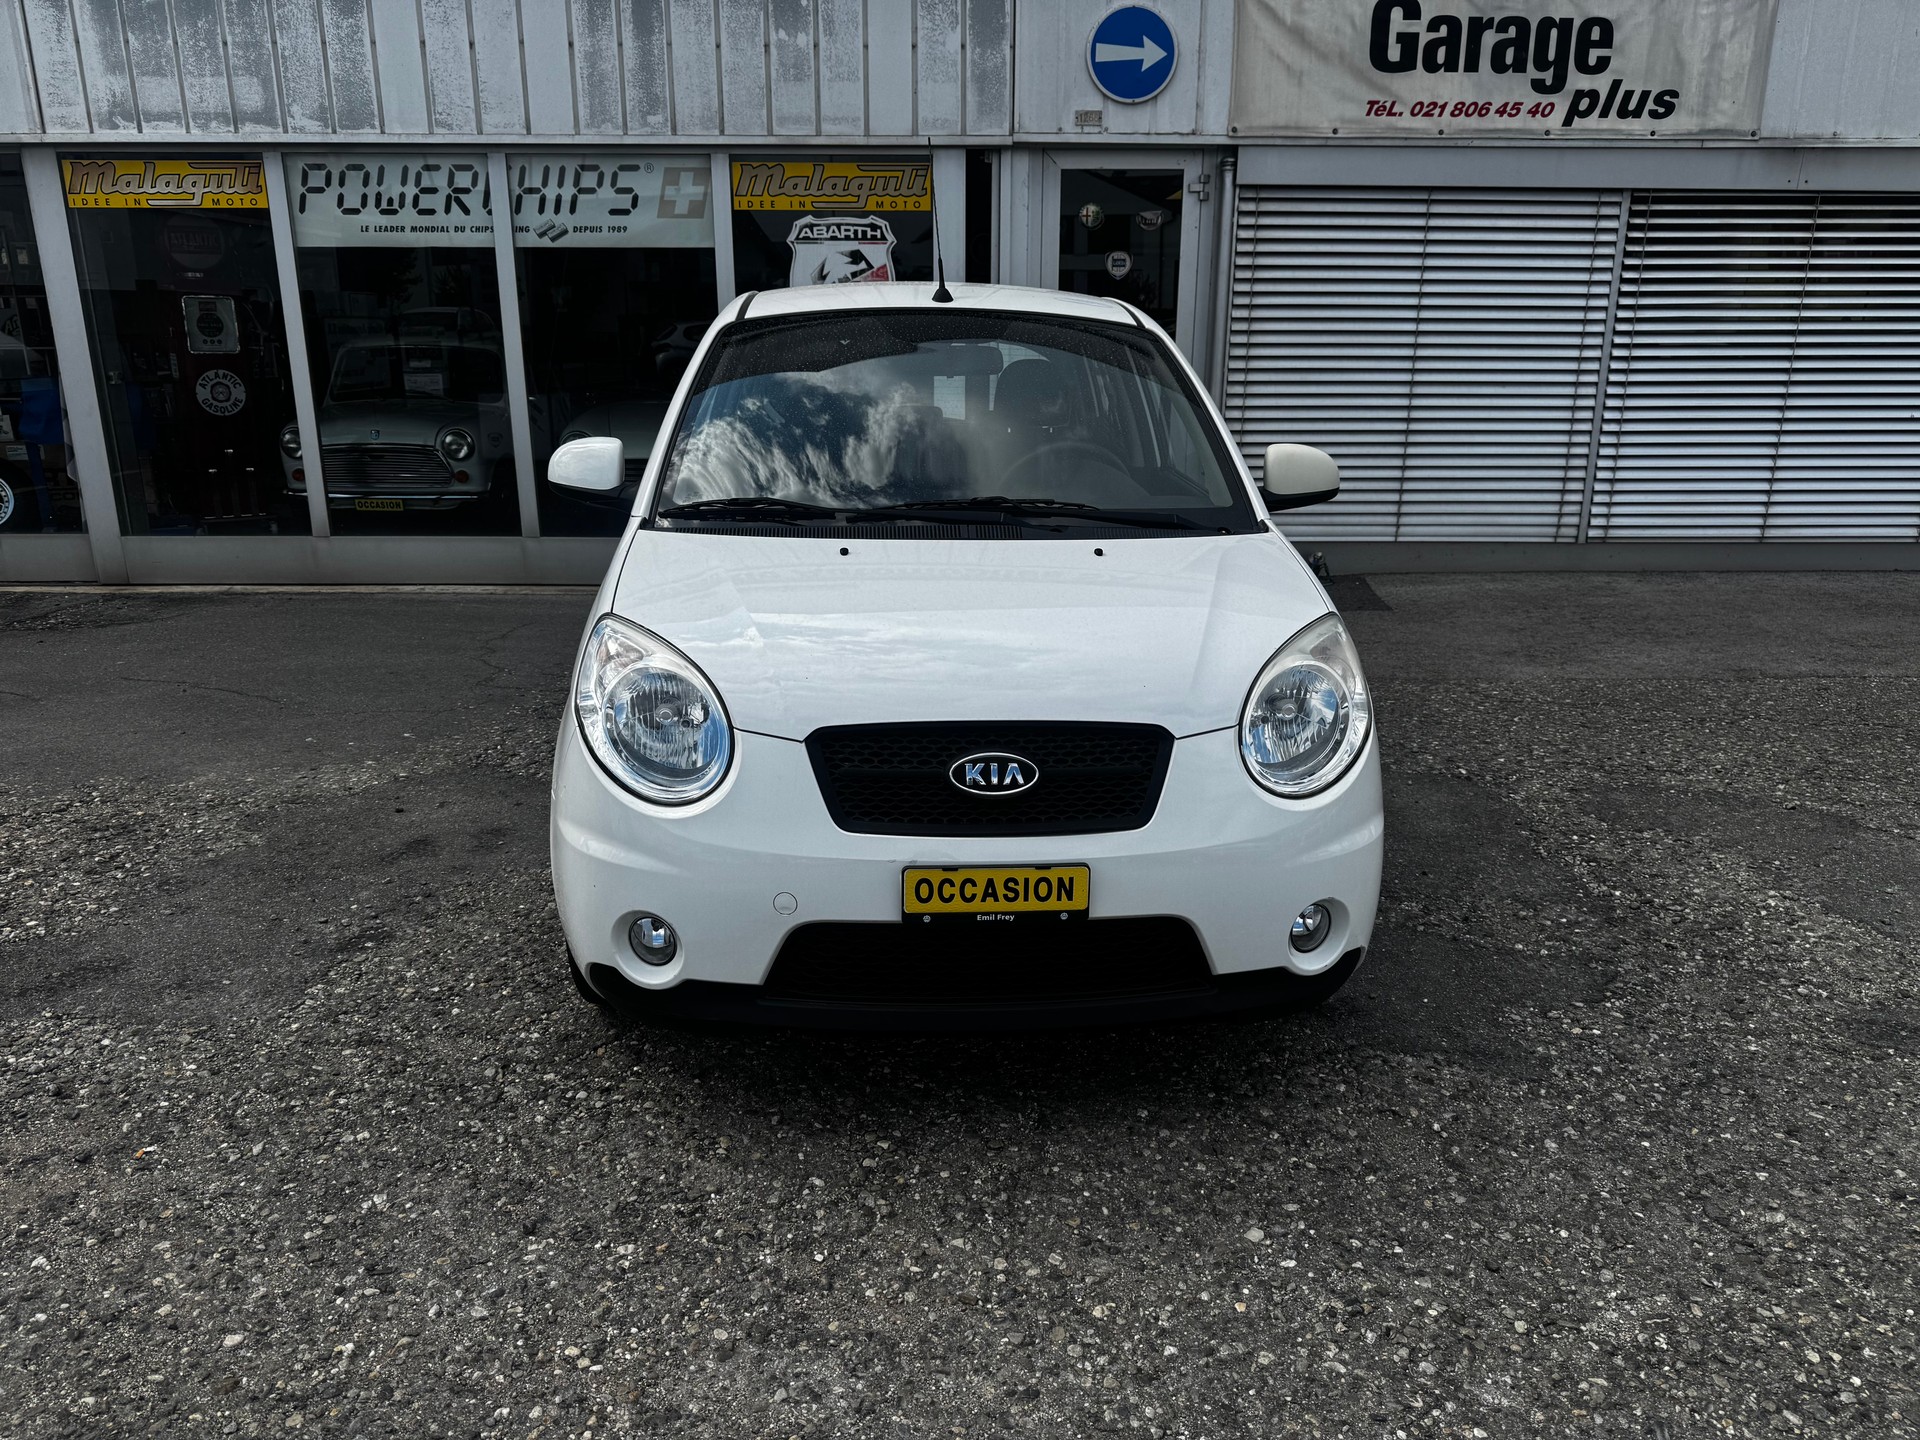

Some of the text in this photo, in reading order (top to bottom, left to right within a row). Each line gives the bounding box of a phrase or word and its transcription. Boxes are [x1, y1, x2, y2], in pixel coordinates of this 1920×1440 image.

[1369, 0, 1614, 94] Garage
[1410, 101, 1448, 117] 021
[1449, 101, 1493, 117] 806
[1494, 102, 1524, 117] 45
[1526, 102, 1555, 118] 40
[1561, 79, 1680, 127] plus
[68, 161, 262, 206] Malaguti
[735, 163, 929, 209] Malaguti
[72, 198, 258, 206] IDEE IN MOTO
[738, 200, 922, 209] IDEE IN MOTO
[360, 225, 370, 233] LE
[374, 225, 406, 233] LEADER
[410, 225, 450, 233] MONDIAL
[454, 225, 466, 233] DU
[470, 225, 494, 233] CHIPS
[799, 226, 881, 239] ABARTH
[198, 371, 241, 389] ATLANTIC
[201, 397, 243, 414] GASOLINE
[357, 501, 402, 509] OCCASION
[965, 763, 1025, 785] KIA
[914, 877, 1075, 904] OCCASION
[977, 914, 1015, 922] Emil Frey
